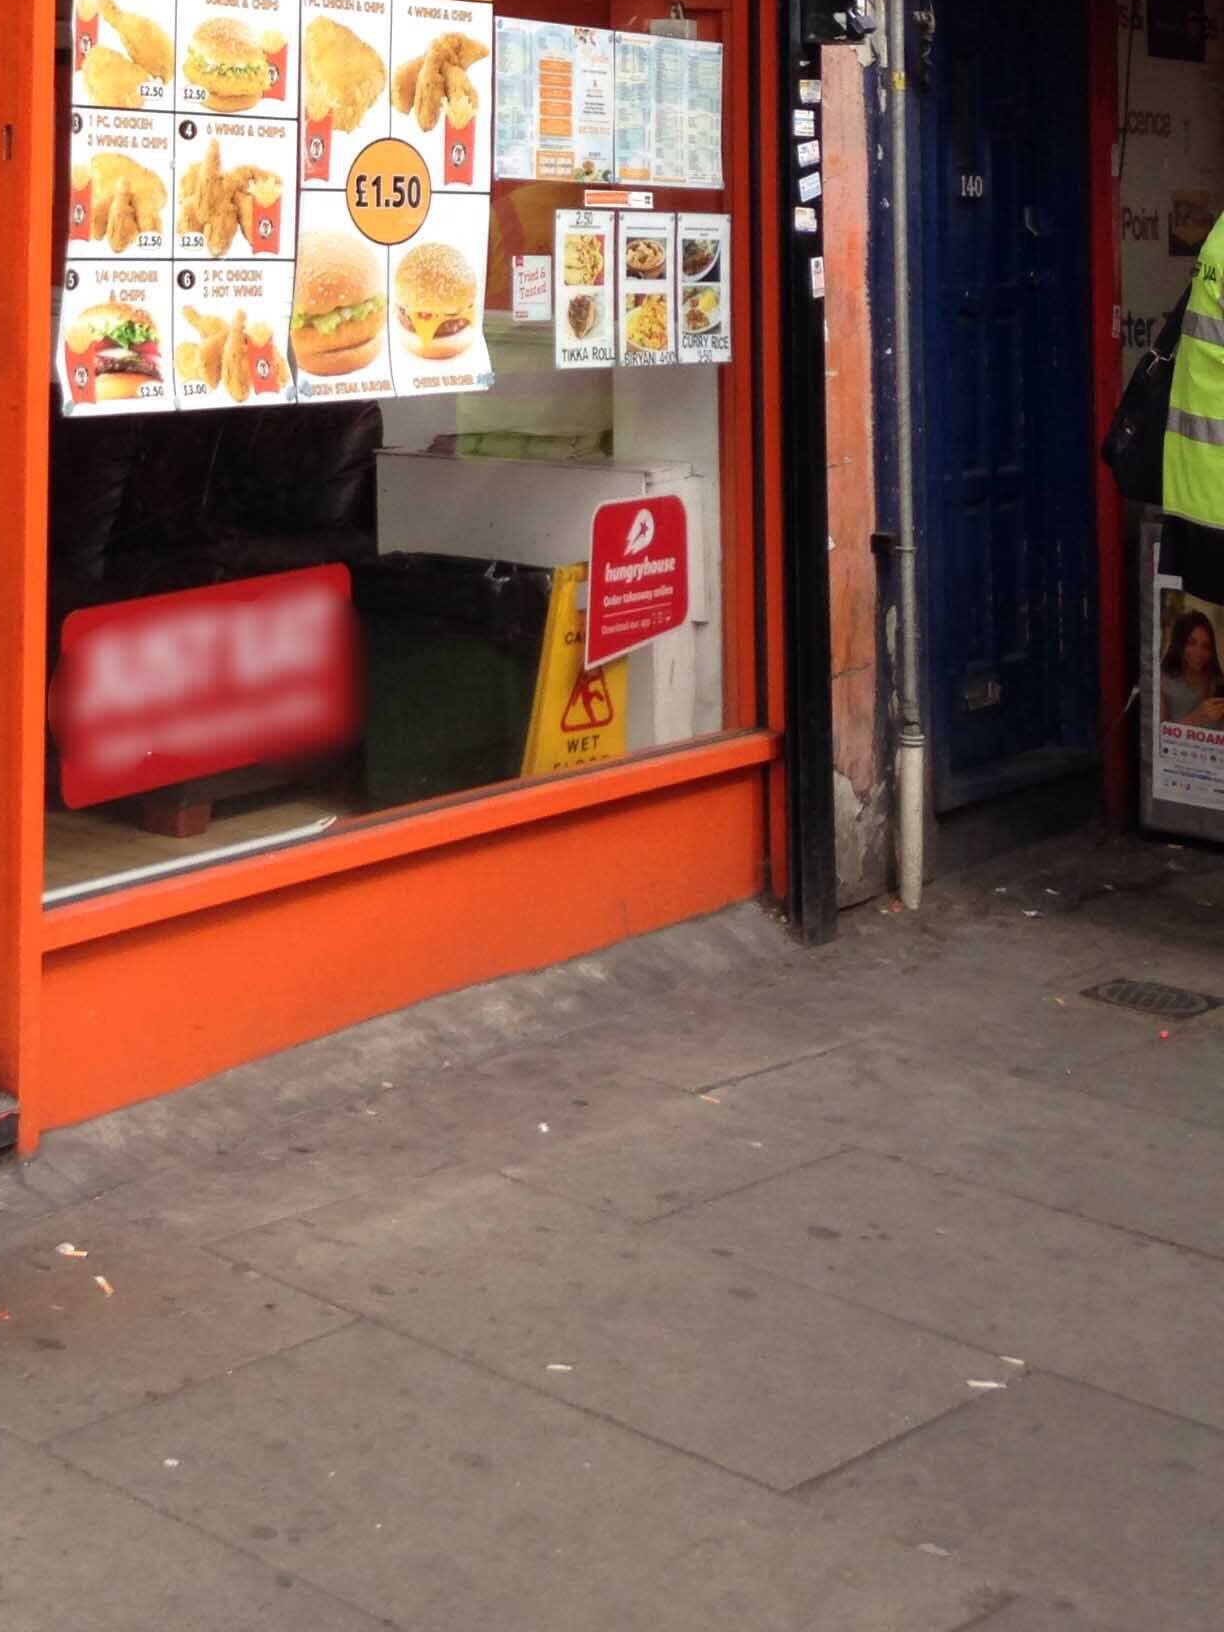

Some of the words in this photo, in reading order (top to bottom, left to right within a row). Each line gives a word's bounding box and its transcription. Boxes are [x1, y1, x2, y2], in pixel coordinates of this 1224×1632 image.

[363, 2, 385, 15] CHIPS
[414, 6, 442, 20] WINGS
[450, 9, 473, 22] CHIPS
[139, 85, 164, 98] £2.50
[183, 88, 207, 101] £2.50
[113, 116, 153, 130] CHICKEN
[215, 124, 245, 137] WINGS
[257, 125, 286, 138] CHIPS
[96, 135, 129, 148] WINGS
[142, 136, 168, 150] CHIPS
[355, 174, 422, 209] £1.50
[961, 174, 983, 198] 140
[1122, 206, 1160, 242] Point
[138, 236, 162, 248] £2.50
[181, 236, 204, 248] £2.50
[95, 270, 109, 285] 1/4
[112, 270, 158, 283] POUNDER
[226, 269, 263, 282] CHICKEN
[119, 289, 146, 302] CHIPS
[211, 285, 230, 297] HOT
[233, 285, 264, 297] WINGS
[682, 335, 708, 348] CURRY
[711, 335, 729, 350] RICE
[562, 347, 588, 362] TIKKA
[624, 352, 656, 366] BIRYANI
[335, 380, 359, 394] STEAK
[361, 379, 392, 393] BURGER
[413, 376, 442, 389] CHEESE
[444, 375, 474, 387] BURGER
[140, 386, 164, 398] £2.50
[184, 383, 207, 396] £3.00
[604, 555, 676, 584] hungryhouse
[1162, 725, 1182, 738] NO
[567, 735, 600, 753] WET
